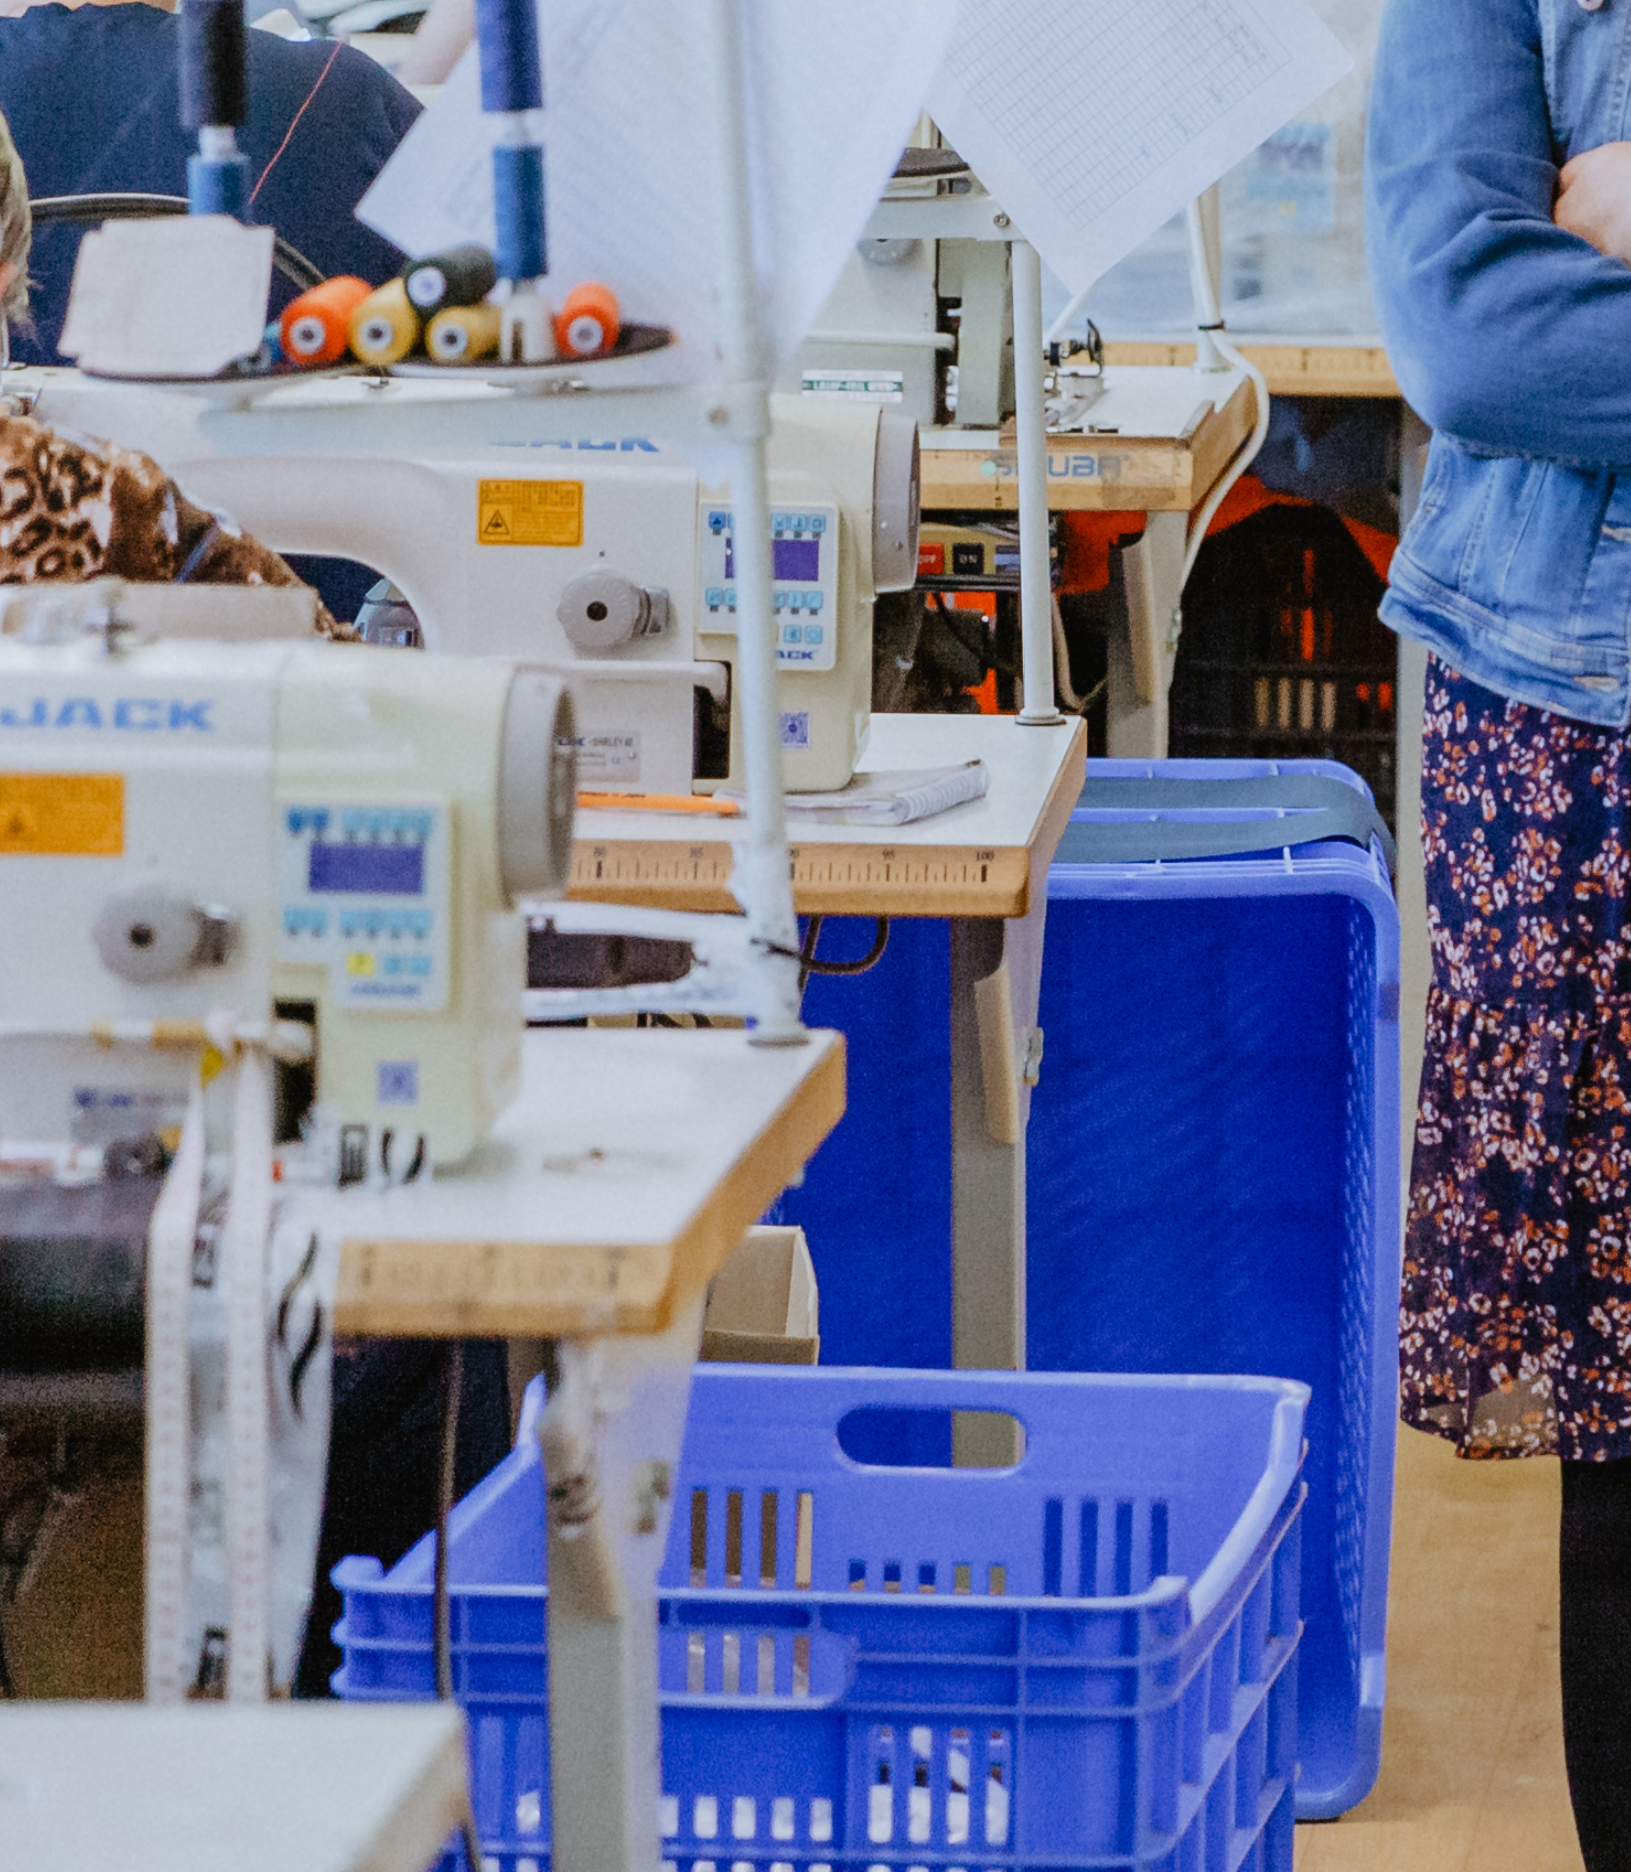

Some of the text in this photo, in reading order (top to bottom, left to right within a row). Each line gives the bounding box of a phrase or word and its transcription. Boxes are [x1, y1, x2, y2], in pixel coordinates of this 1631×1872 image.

[775, 649, 813, 660] ACK
[0, 697, 214, 732] JACK
[975, 850, 995, 862] 100
